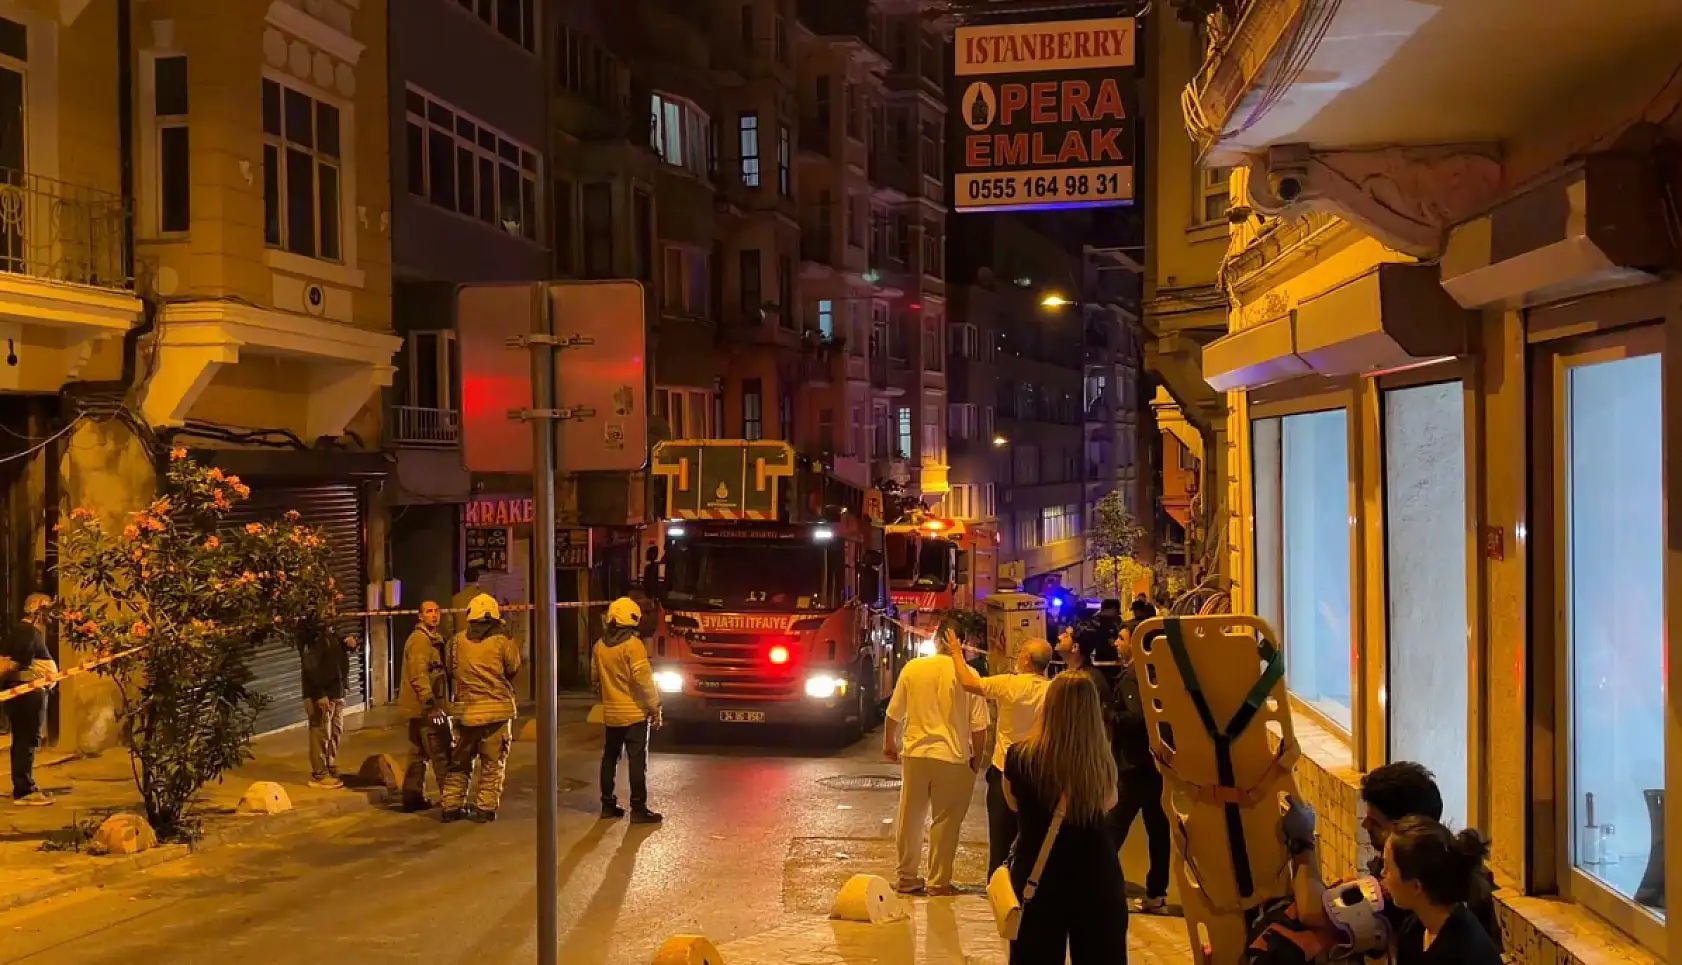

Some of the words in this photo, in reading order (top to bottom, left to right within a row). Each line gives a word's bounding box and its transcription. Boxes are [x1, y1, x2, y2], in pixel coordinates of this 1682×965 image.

[965, 29, 1128, 64] ISTANBERRY
[965, 127, 1124, 167] EMLAK
[968, 178, 1016, 200] 0555
[1023, 175, 1059, 198] 164
[1065, 174, 1089, 196] 98
[1096, 172, 1118, 194] 31
